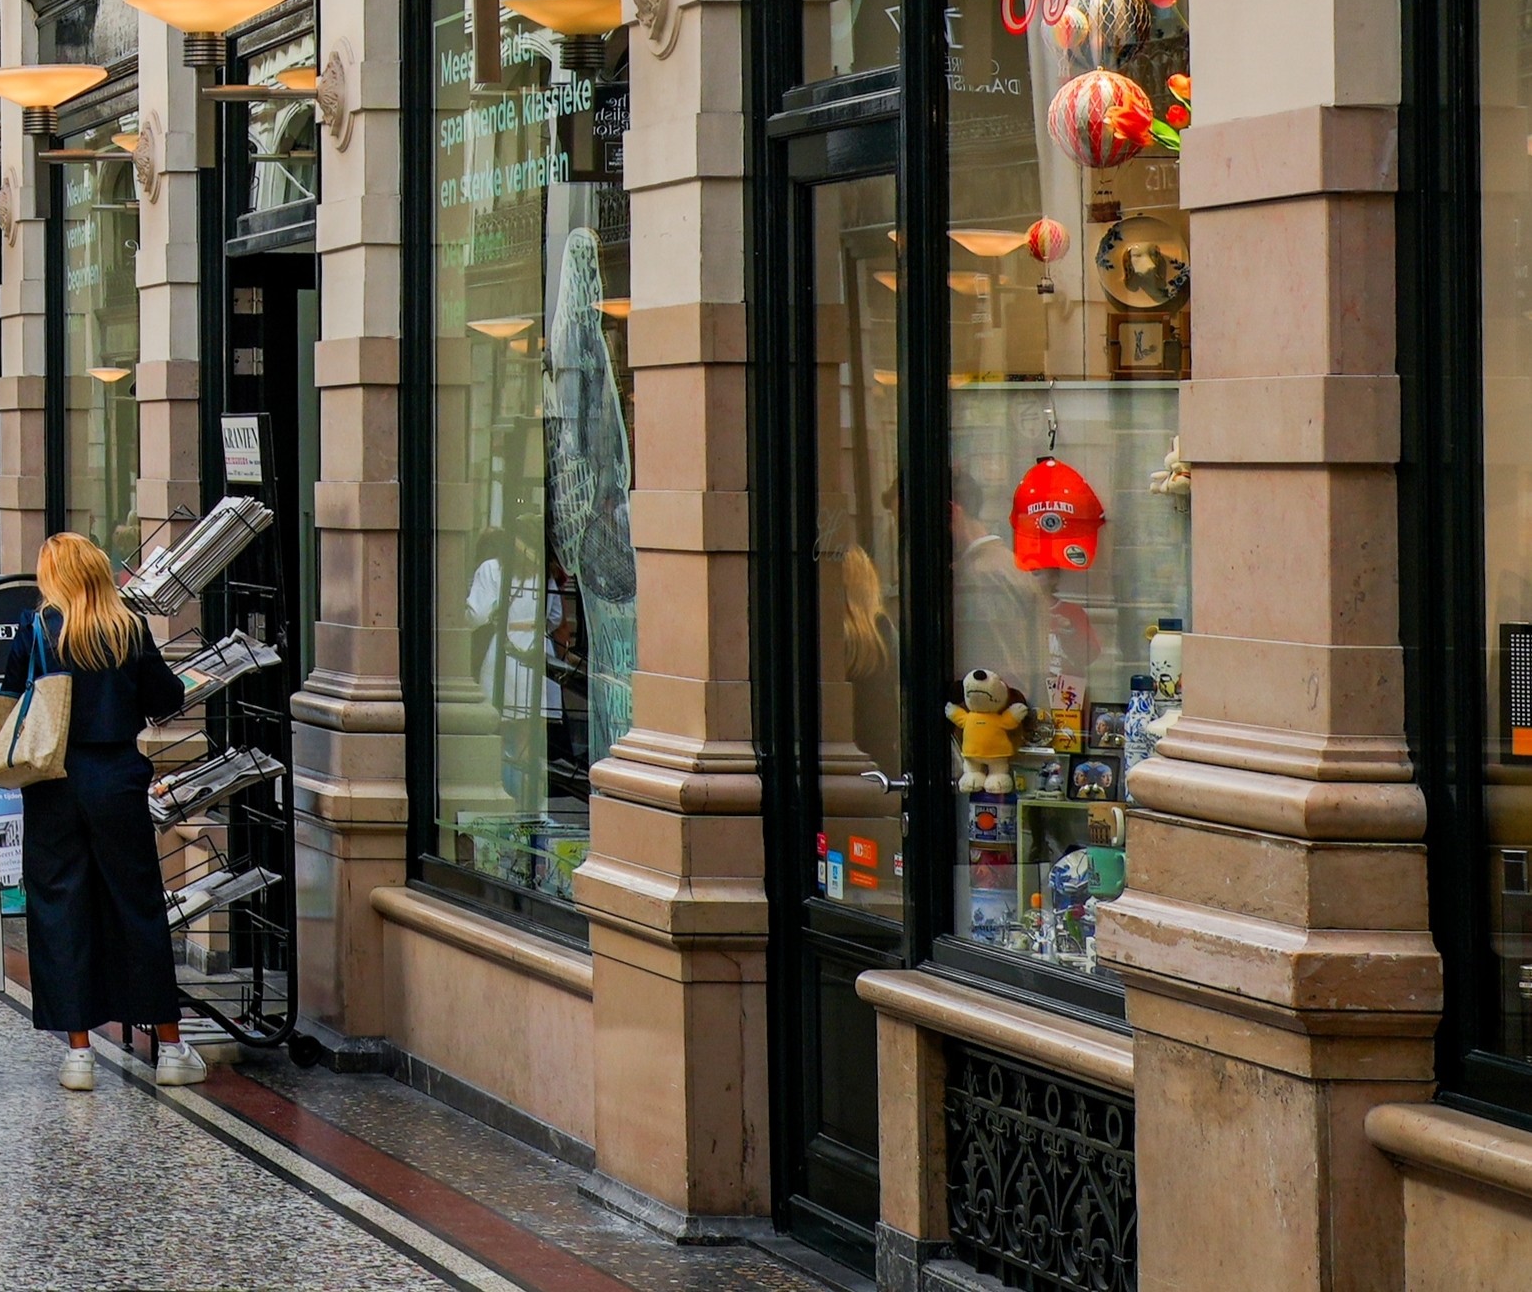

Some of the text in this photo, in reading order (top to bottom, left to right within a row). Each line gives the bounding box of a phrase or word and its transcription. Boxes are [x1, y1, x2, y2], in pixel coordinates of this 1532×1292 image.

[441, 23, 535, 87] Meesnde,
[440, 71, 592, 155] spannende, klassieke
[440, 145, 569, 208] en sterke verhalen
[1027, 500, 1074, 515] HOLLAND
